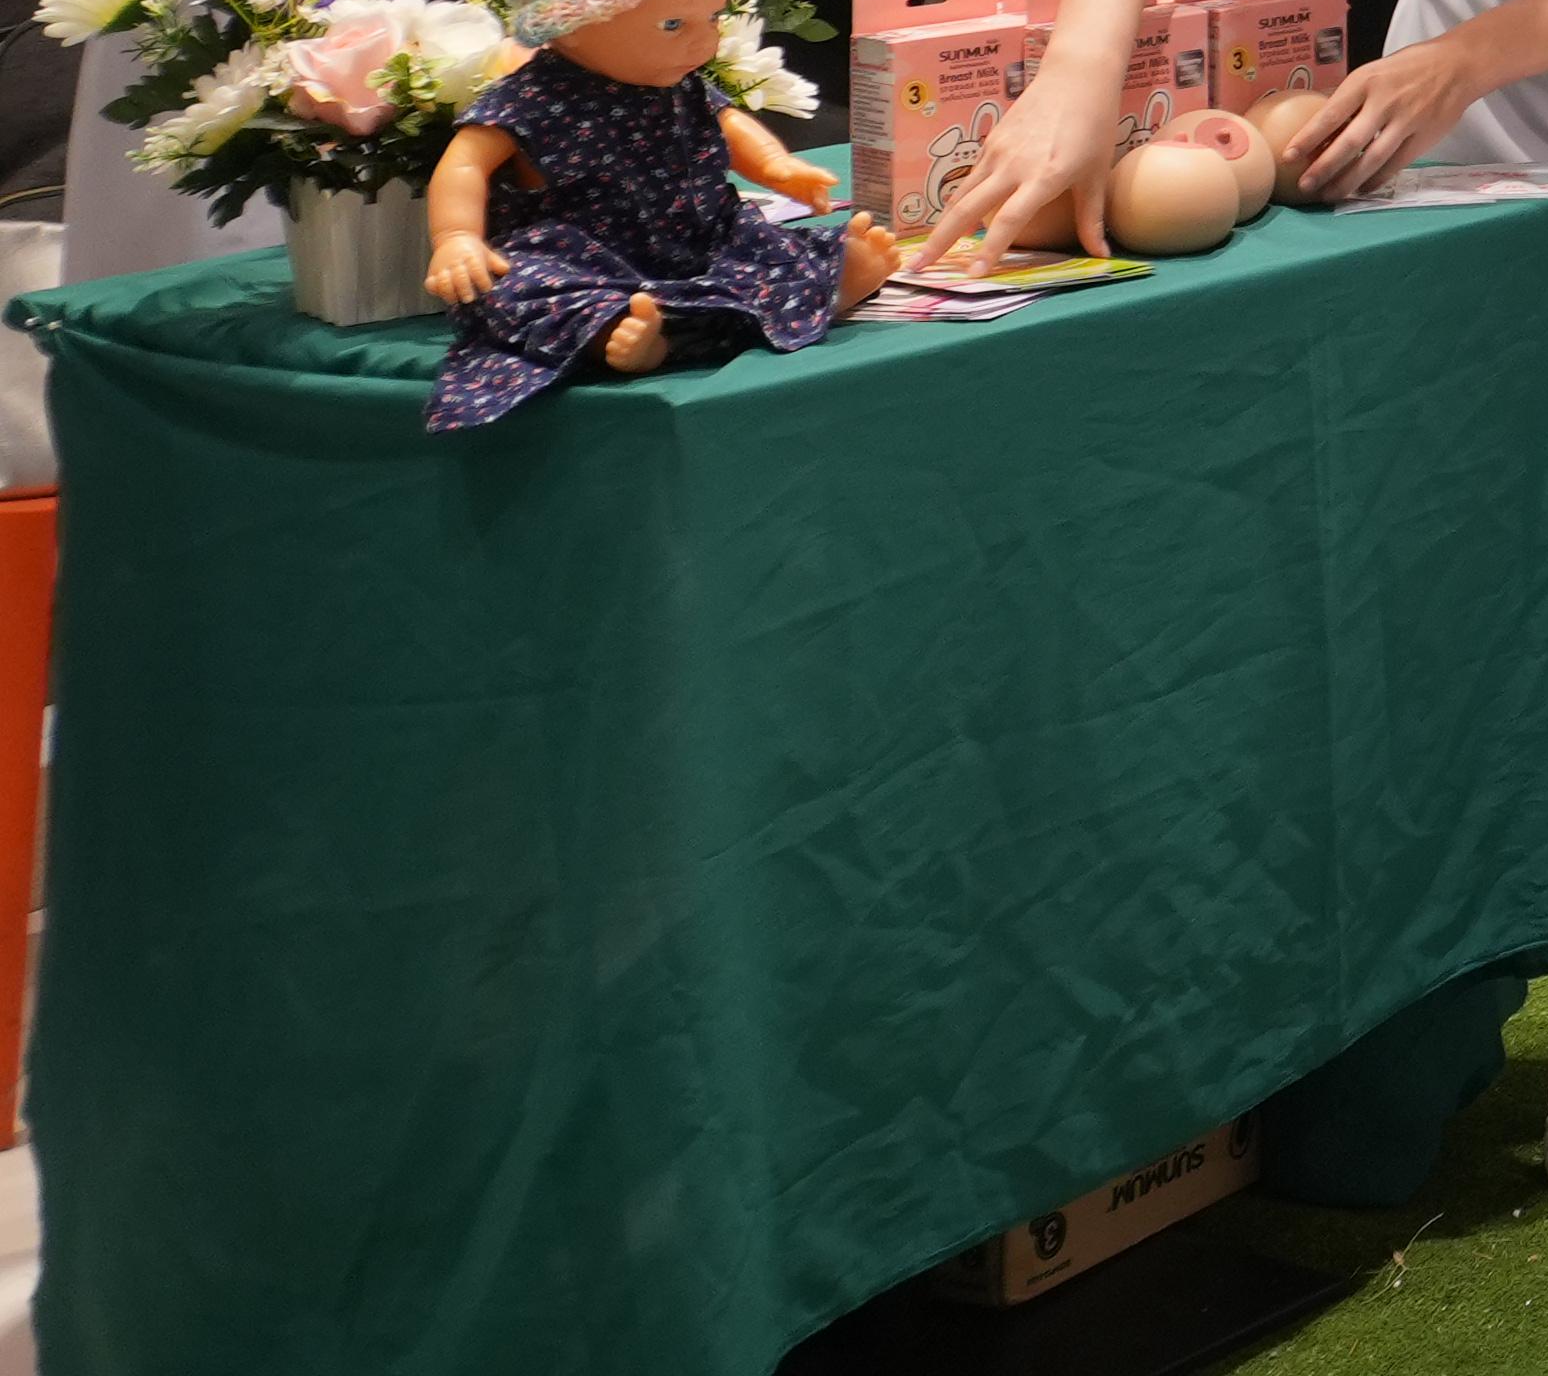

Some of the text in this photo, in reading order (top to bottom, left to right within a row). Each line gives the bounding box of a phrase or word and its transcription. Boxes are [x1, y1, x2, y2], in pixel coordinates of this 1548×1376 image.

[1233, 52, 1243, 70] 3
[939, 67, 999, 84] Breast Milk
[909, 86, 921, 105] 3
